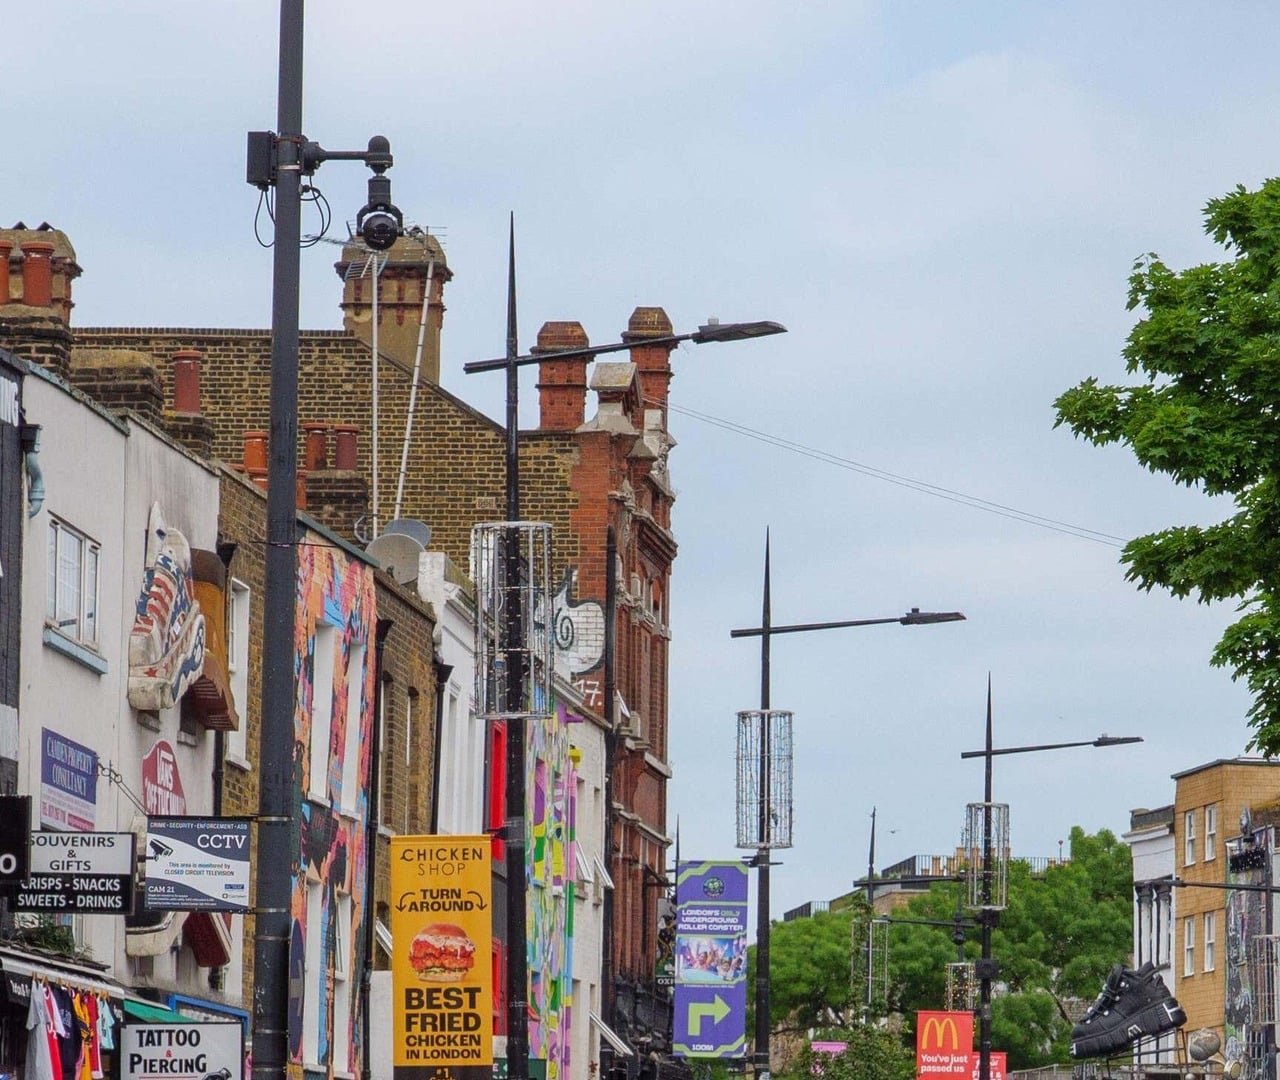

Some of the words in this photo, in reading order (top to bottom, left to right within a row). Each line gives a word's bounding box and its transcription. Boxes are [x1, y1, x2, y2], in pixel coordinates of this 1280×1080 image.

[68, 743, 93, 776] PROPERTY
[30, 836, 115, 848] SOUVENIRS
[197, 834, 247, 849] CCTV
[67, 849, 77, 859] &
[400, 847, 483, 862] CHICKEN
[50, 860, 92, 871] GIFTS
[418, 862, 466, 876] SHOP
[21, 878, 63, 890] CRISPS
[73, 878, 121, 891] SNACKS
[17, 894, 66, 908] SWEETS
[76, 895, 123, 908] DRINKS
[420, 889, 461, 900] TURN
[408, 900, 475, 912] AROUND
[682, 916, 738, 924] UNDERGROUND
[404, 986, 481, 1010] BEST
[405, 1012, 482, 1033] FRIED
[136, 1029, 200, 1048] TATTOO
[405, 1034, 481, 1047] CHICKEN
[165, 1049, 173, 1058] &
[406, 1048, 421, 1059] IN
[423, 1048, 481, 1059] LONDON
[921, 1054, 949, 1063] You've
[950, 1054, 968, 1065] just
[129, 1053, 207, 1074] PIERCING
[921, 1063, 952, 1074] passed
[954, 1065, 965, 1073] us
